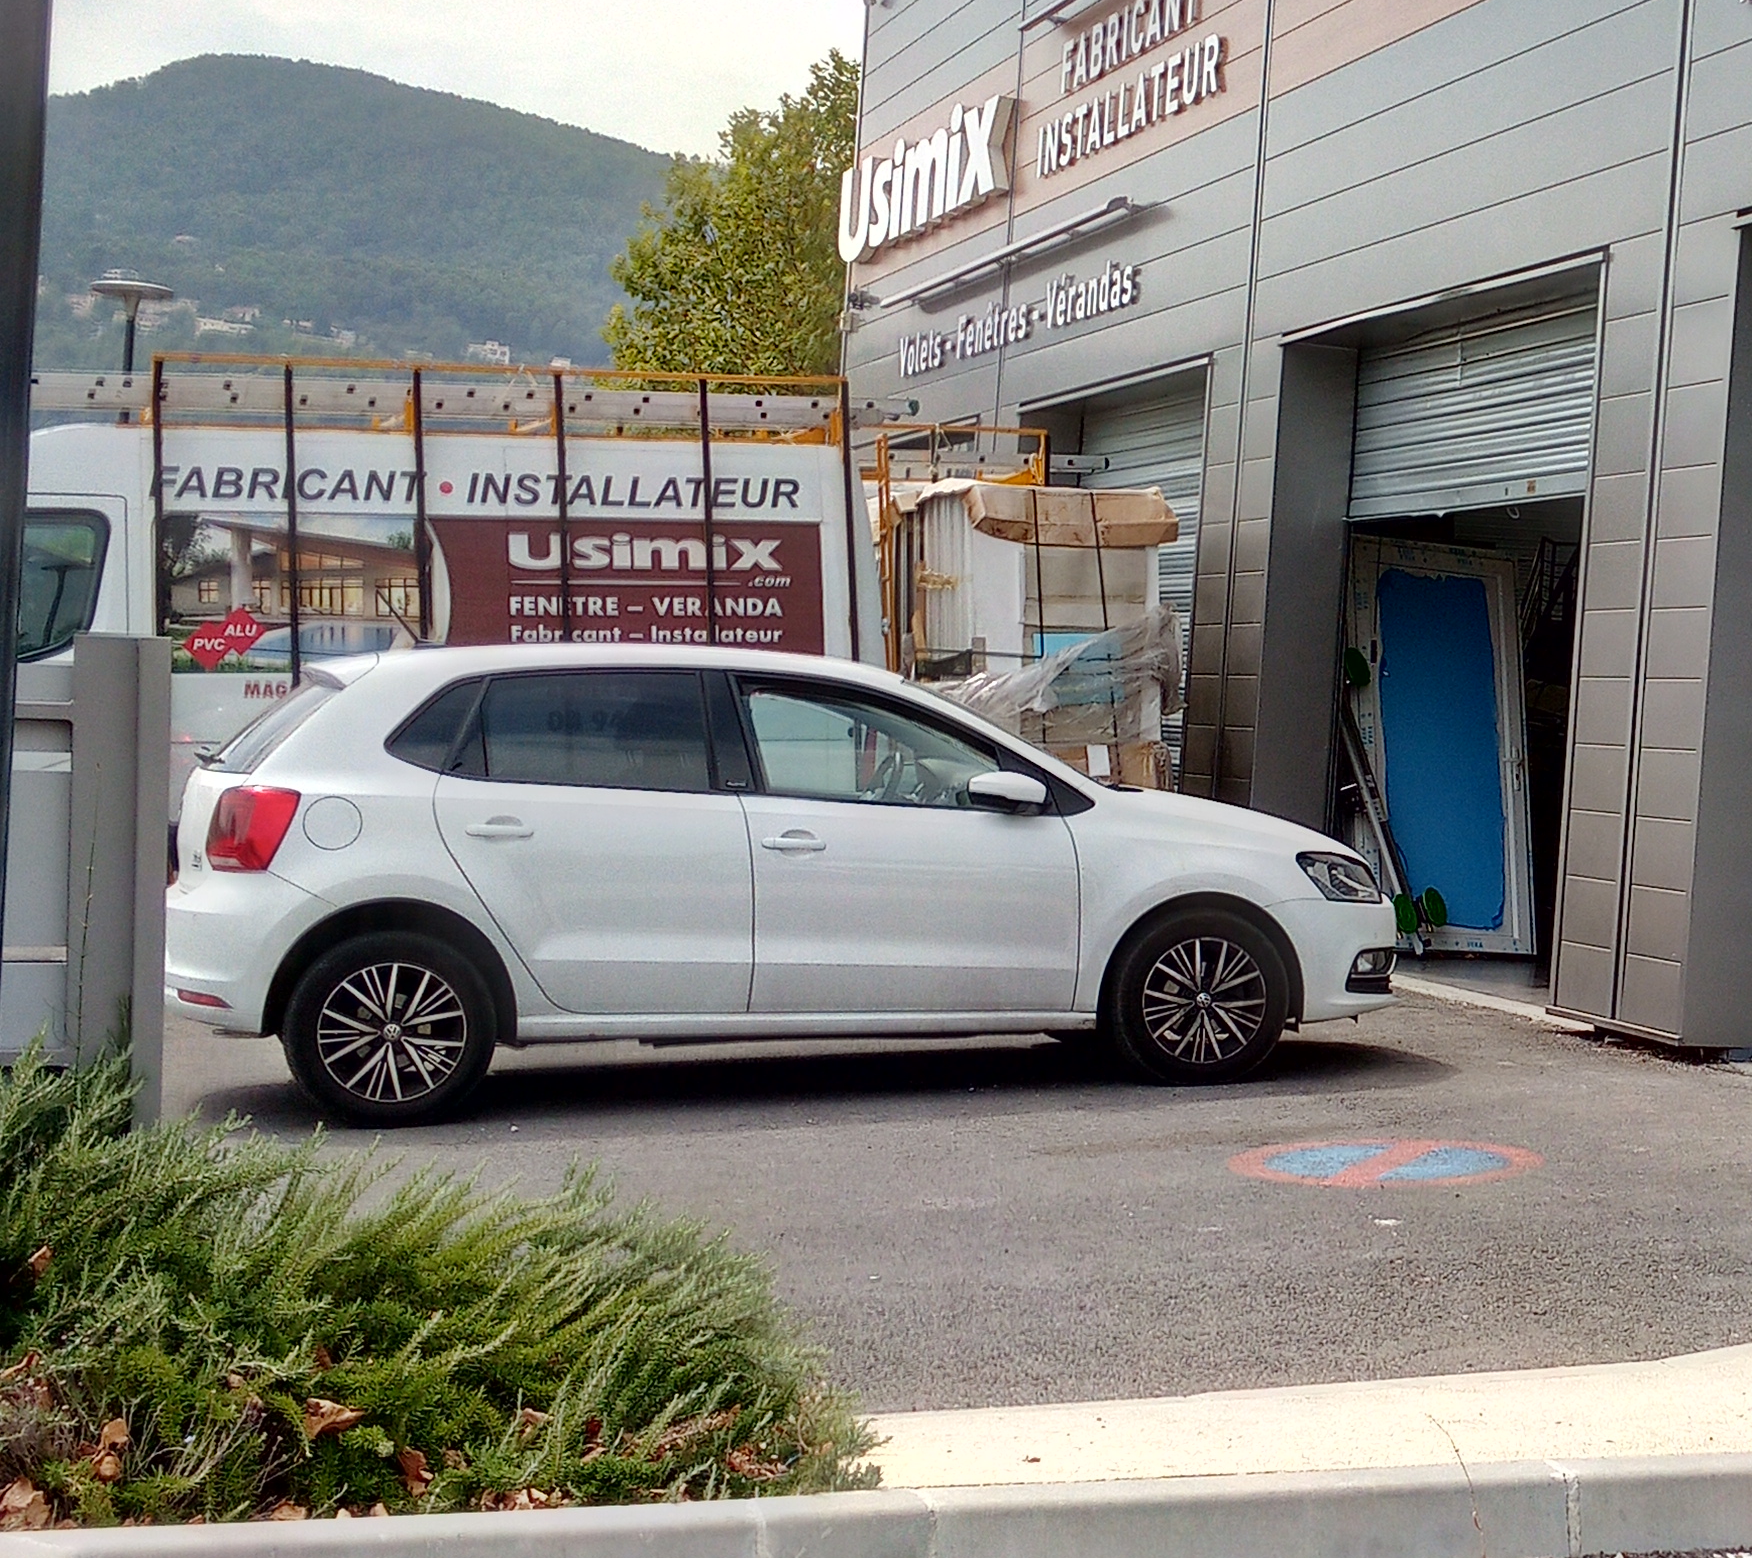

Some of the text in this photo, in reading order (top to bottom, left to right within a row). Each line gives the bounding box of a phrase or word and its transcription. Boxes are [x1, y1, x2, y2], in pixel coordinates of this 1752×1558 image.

[1036, 33, 1222, 179] INSTALLATEUR
[899, 329, 943, 378] Volets
[955, 301, 1029, 360] Fenêtres
[1046, 260, 1135, 330] Vérandas
[466, 472, 800, 509] INSTALLATEUR
[193, 638, 226, 651] PVC
[224, 623, 257, 637] ALU
[510, 623, 621, 643] Fabrcant
[650, 624, 783, 644] Instalateur
